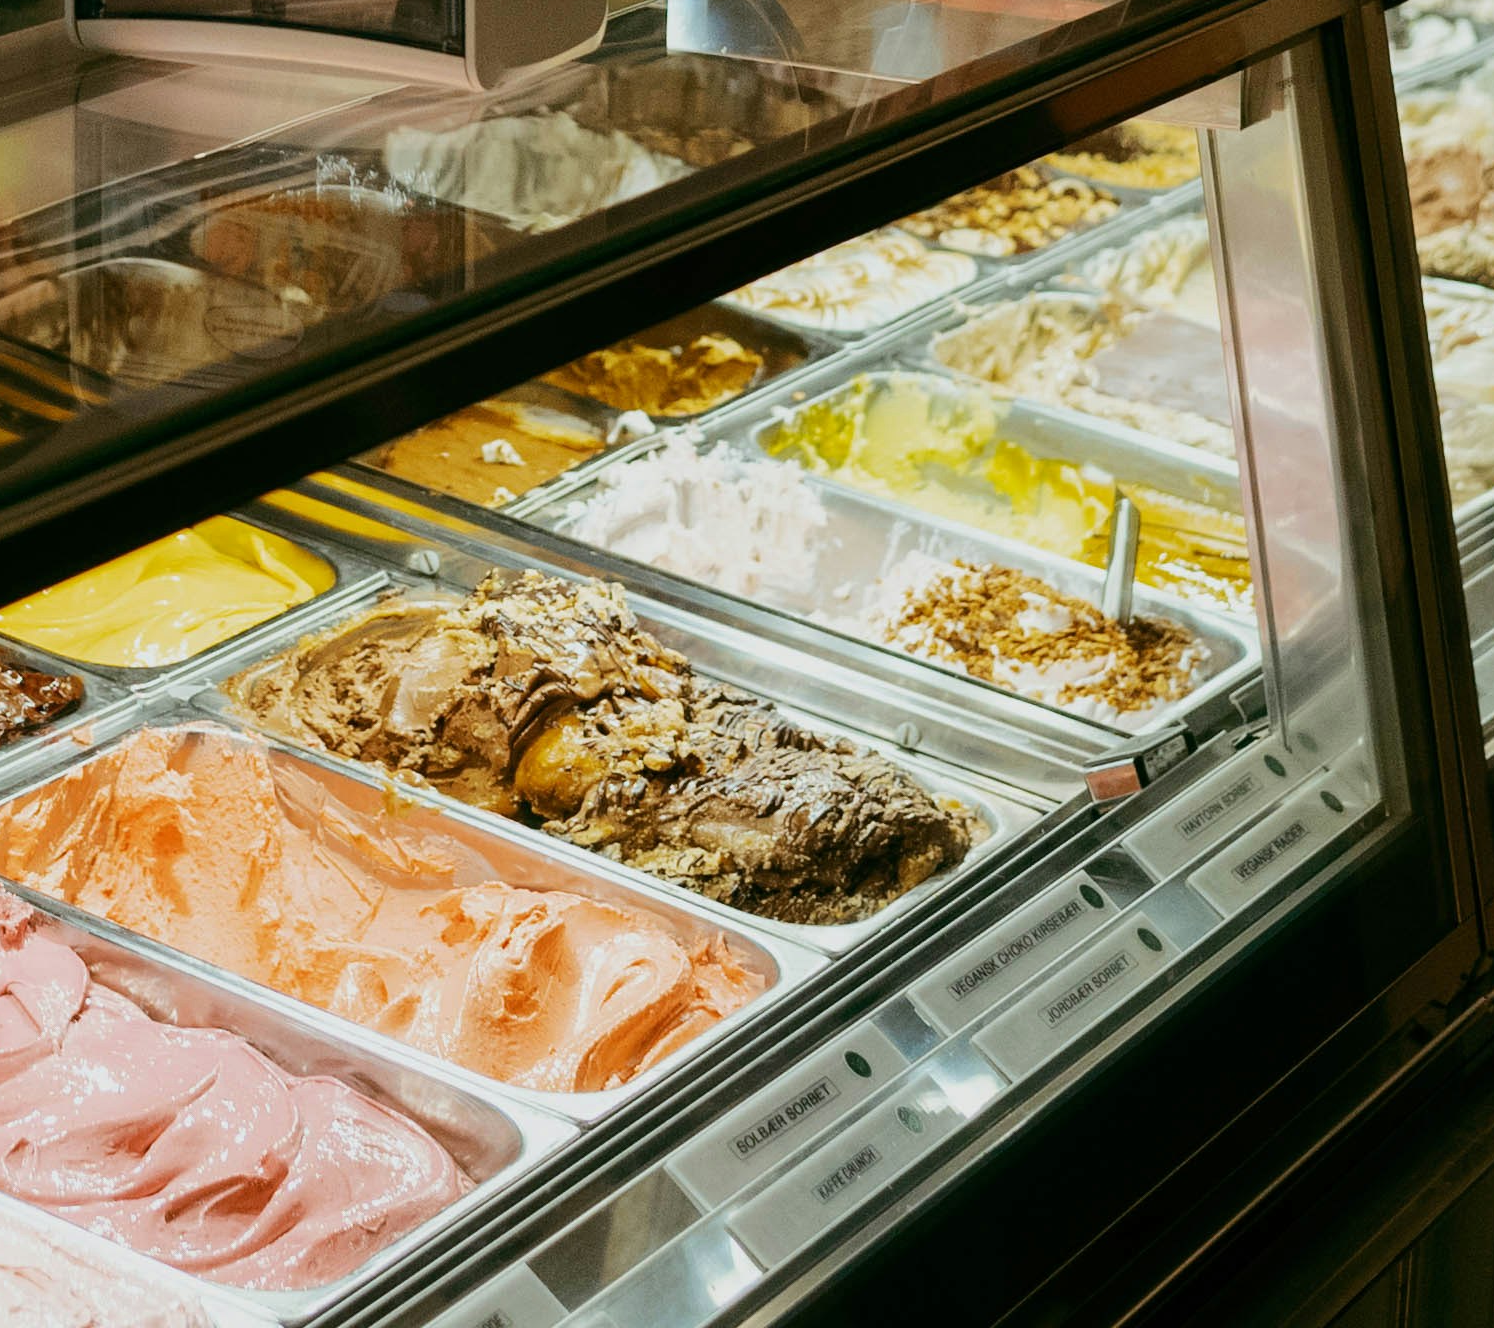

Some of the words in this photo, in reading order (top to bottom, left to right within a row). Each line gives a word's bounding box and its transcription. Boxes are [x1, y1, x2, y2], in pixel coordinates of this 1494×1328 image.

[1180, 805, 1224, 835] HAVTORN
[1221, 776, 1256, 810] SORBET
[1235, 850, 1277, 879] VEGANSK
[950, 959, 1000, 997] VEGANSK
[996, 934, 1034, 966] CHOKO
[1031, 901, 1082, 942] KIRSEBÆR
[1046, 987, 1093, 1024] JORDBÆR
[1091, 954, 1132, 989] SORBET
[736, 1114, 788, 1154] SOLBÆR
[785, 1083, 831, 1121] SORBET
[817, 1173, 846, 1200] KAFFE
[842, 1149, 878, 1180] CRUNCH
